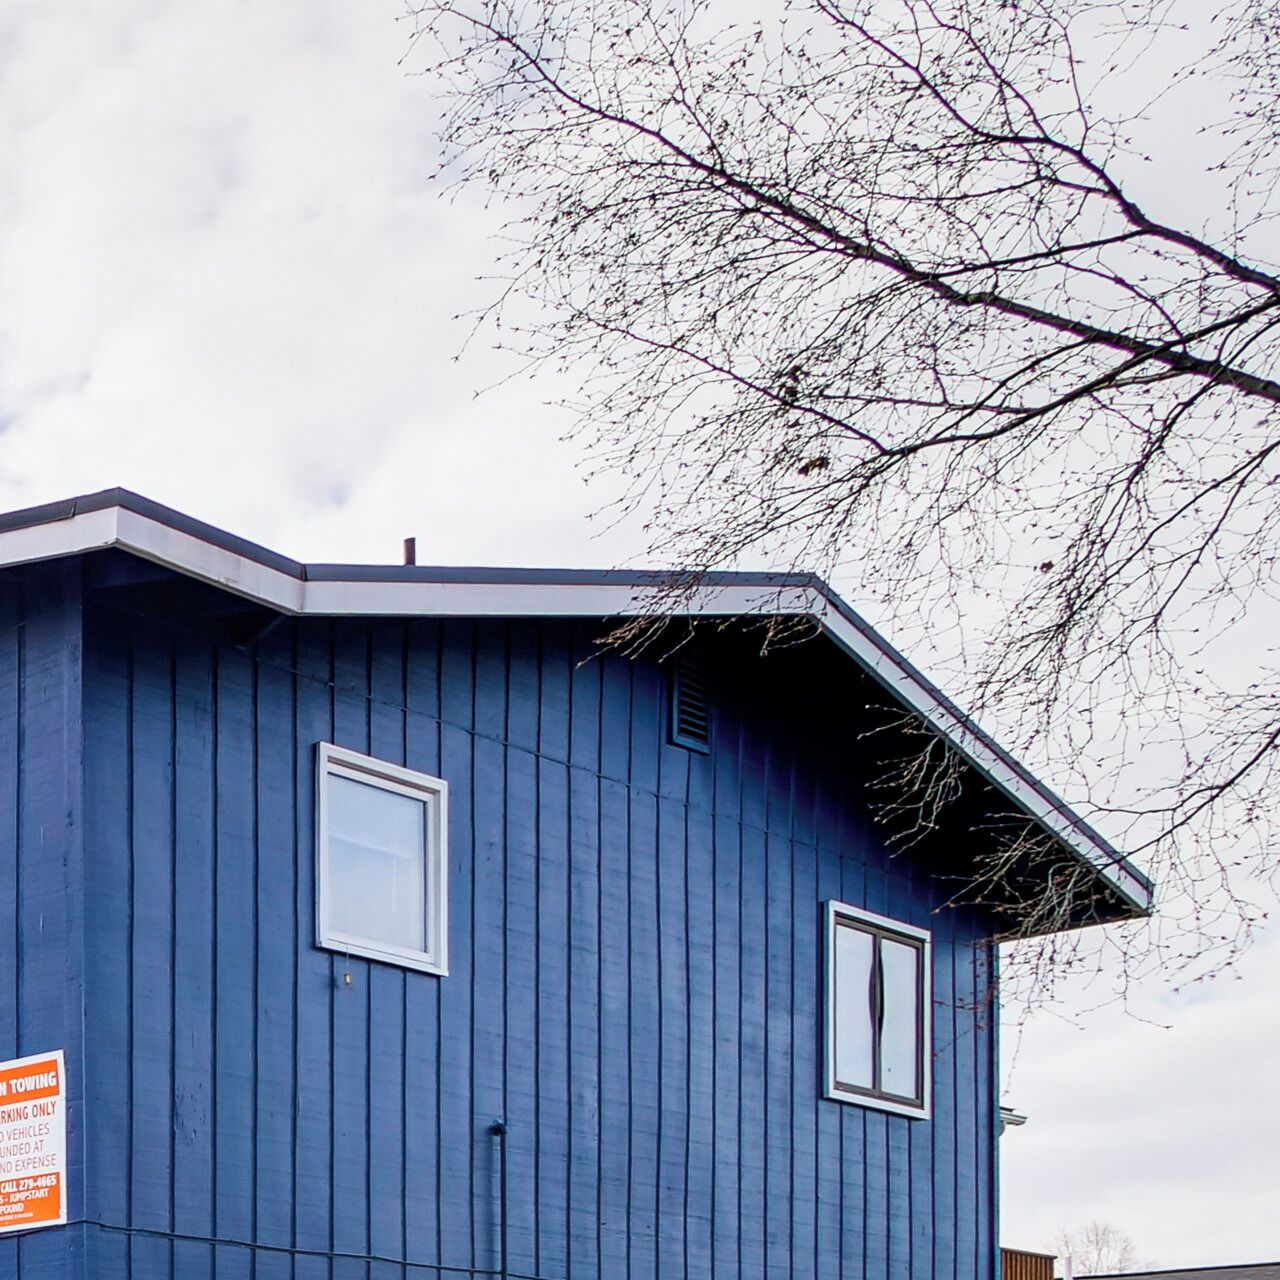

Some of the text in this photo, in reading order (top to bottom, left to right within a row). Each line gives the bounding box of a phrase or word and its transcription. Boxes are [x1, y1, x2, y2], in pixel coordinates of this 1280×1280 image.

[9, 1071, 56, 1094] TOWING
[32, 1101, 57, 1118] ONLY
[6, 1122, 50, 1140] VEHICLES
[33, 1139, 45, 1153] AT
[15, 1153, 57, 1171] EXPENSE
[0, 1180, 18, 1193] CALL
[9, 1188, 49, 1203] JUMPSTART
